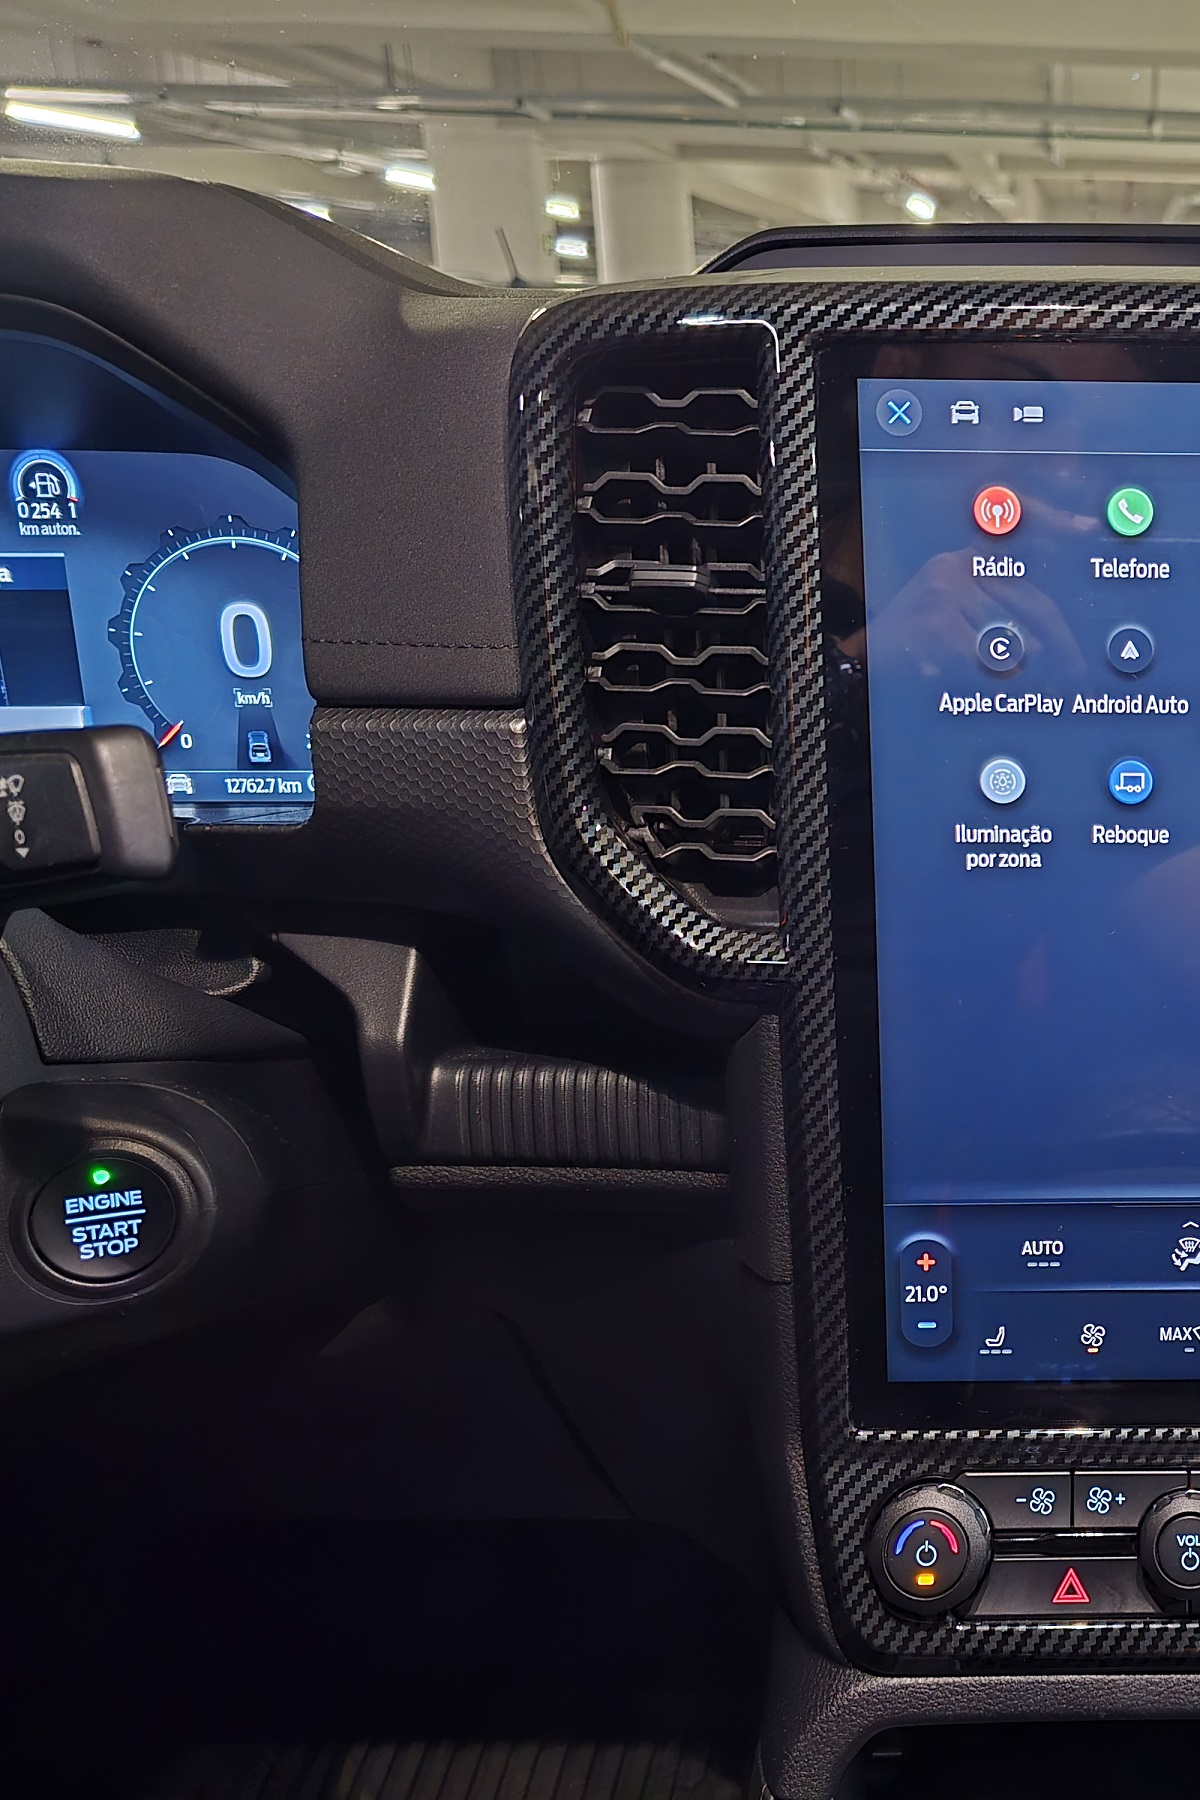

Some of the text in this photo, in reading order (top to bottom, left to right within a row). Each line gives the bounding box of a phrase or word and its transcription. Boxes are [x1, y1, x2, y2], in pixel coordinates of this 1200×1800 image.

[30, 502, 62, 519] 254
[19, 521, 82, 536] km auton.
[972, 556, 1026, 578] Rádio
[1090, 557, 1171, 579] Telefone
[219, 602, 273, 679] 0
[236, 691, 272, 706] km/h
[938, 692, 1064, 717] Apple CarPlay
[1071, 693, 1190, 714] Android Auto
[180, 733, 193, 749] 0
[224, 777, 276, 794] 12762.7
[277, 777, 303, 794] km
[954, 823, 1053, 848] Iluminação
[1091, 824, 1170, 847] Reboque
[965, 852, 1043, 871] por zona
[65, 1190, 143, 1215] ENGINE
[72, 1219, 142, 1243] START
[80, 1237, 139, 1260] STOP
[1021, 1240, 1064, 1256] AUTO
[904, 1285, 948, 1303] 21.0°
[1159, 1326, 1193, 1341] MAX
